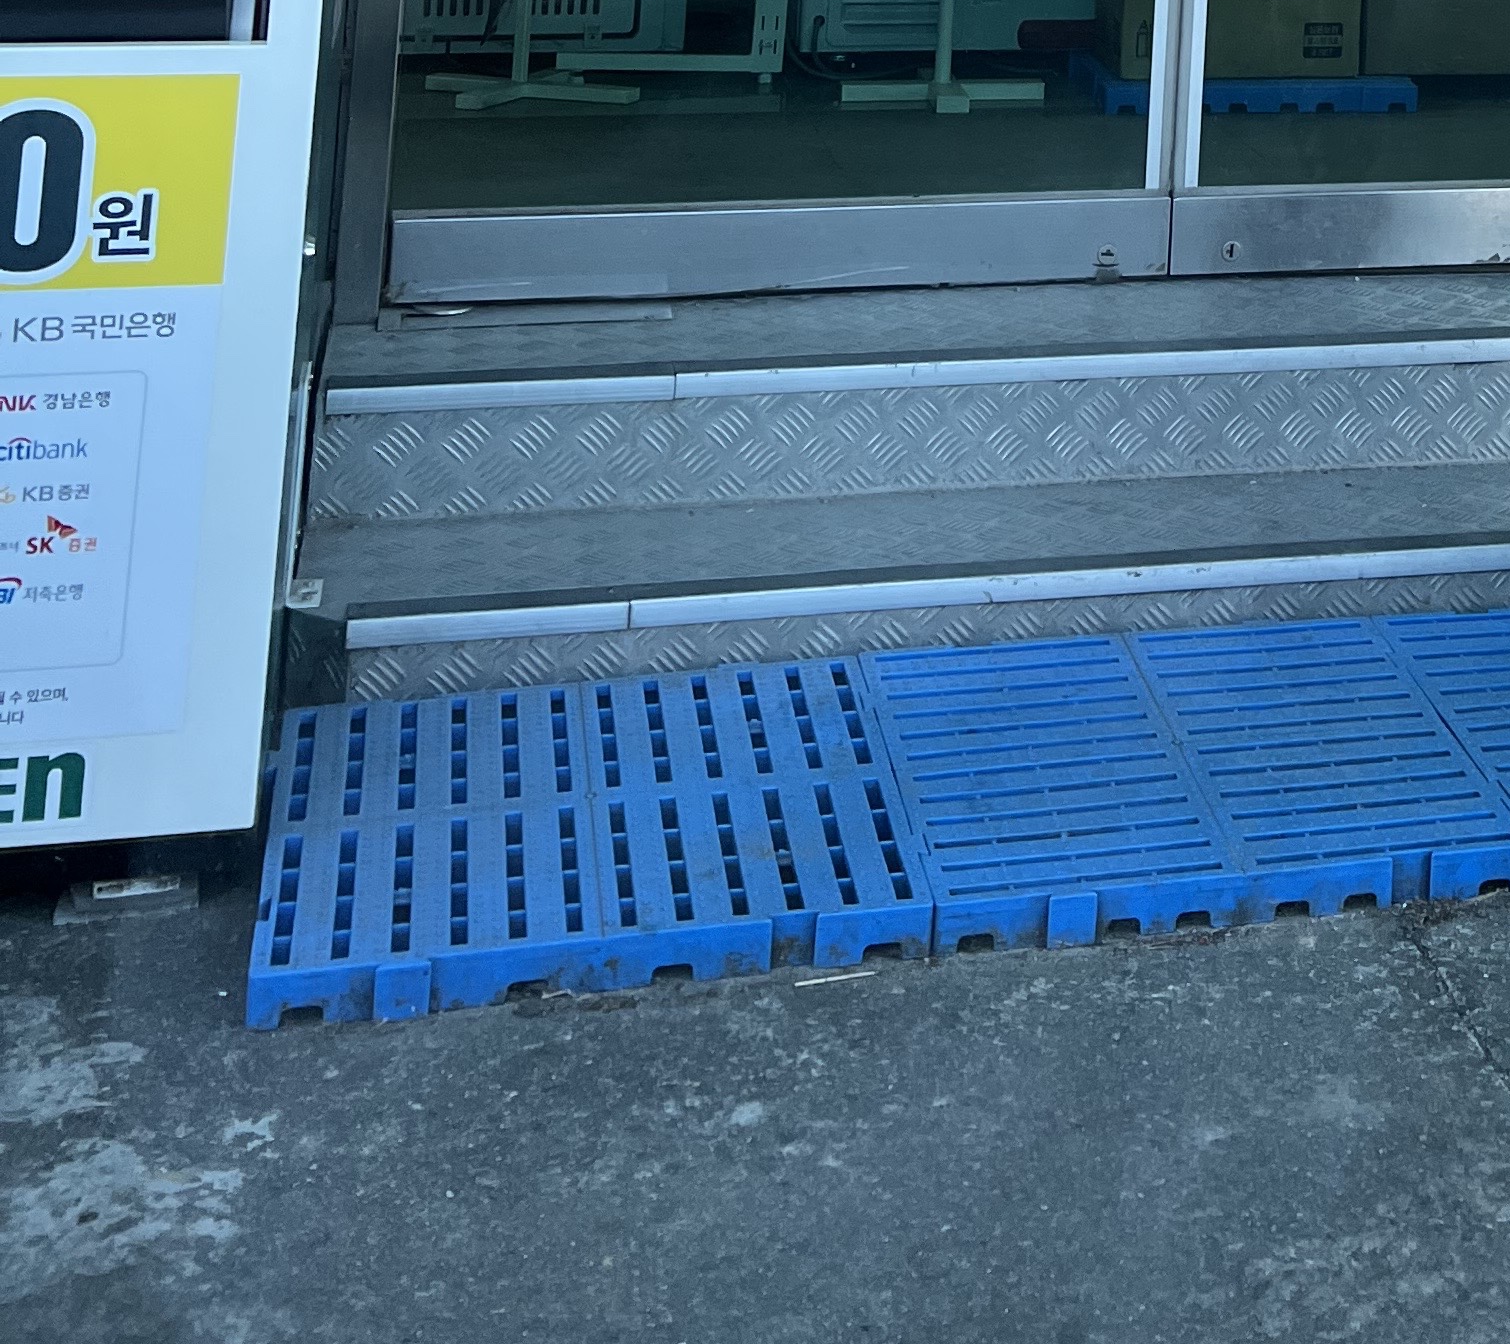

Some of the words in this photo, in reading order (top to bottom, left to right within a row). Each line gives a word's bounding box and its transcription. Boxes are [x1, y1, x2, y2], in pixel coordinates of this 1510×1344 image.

[13, 317, 64, 343] KB
[71, 311, 177, 339] 국민은행
[0, 394, 37, 411] NK
[43, 391, 111, 410] 경남은행
[0, 437, 88, 461] citibank
[22, 486, 54, 502] KB
[58, 483, 90, 500] 증권
[25, 536, 55, 555] SK
[9, 690, 22, 703] 수
